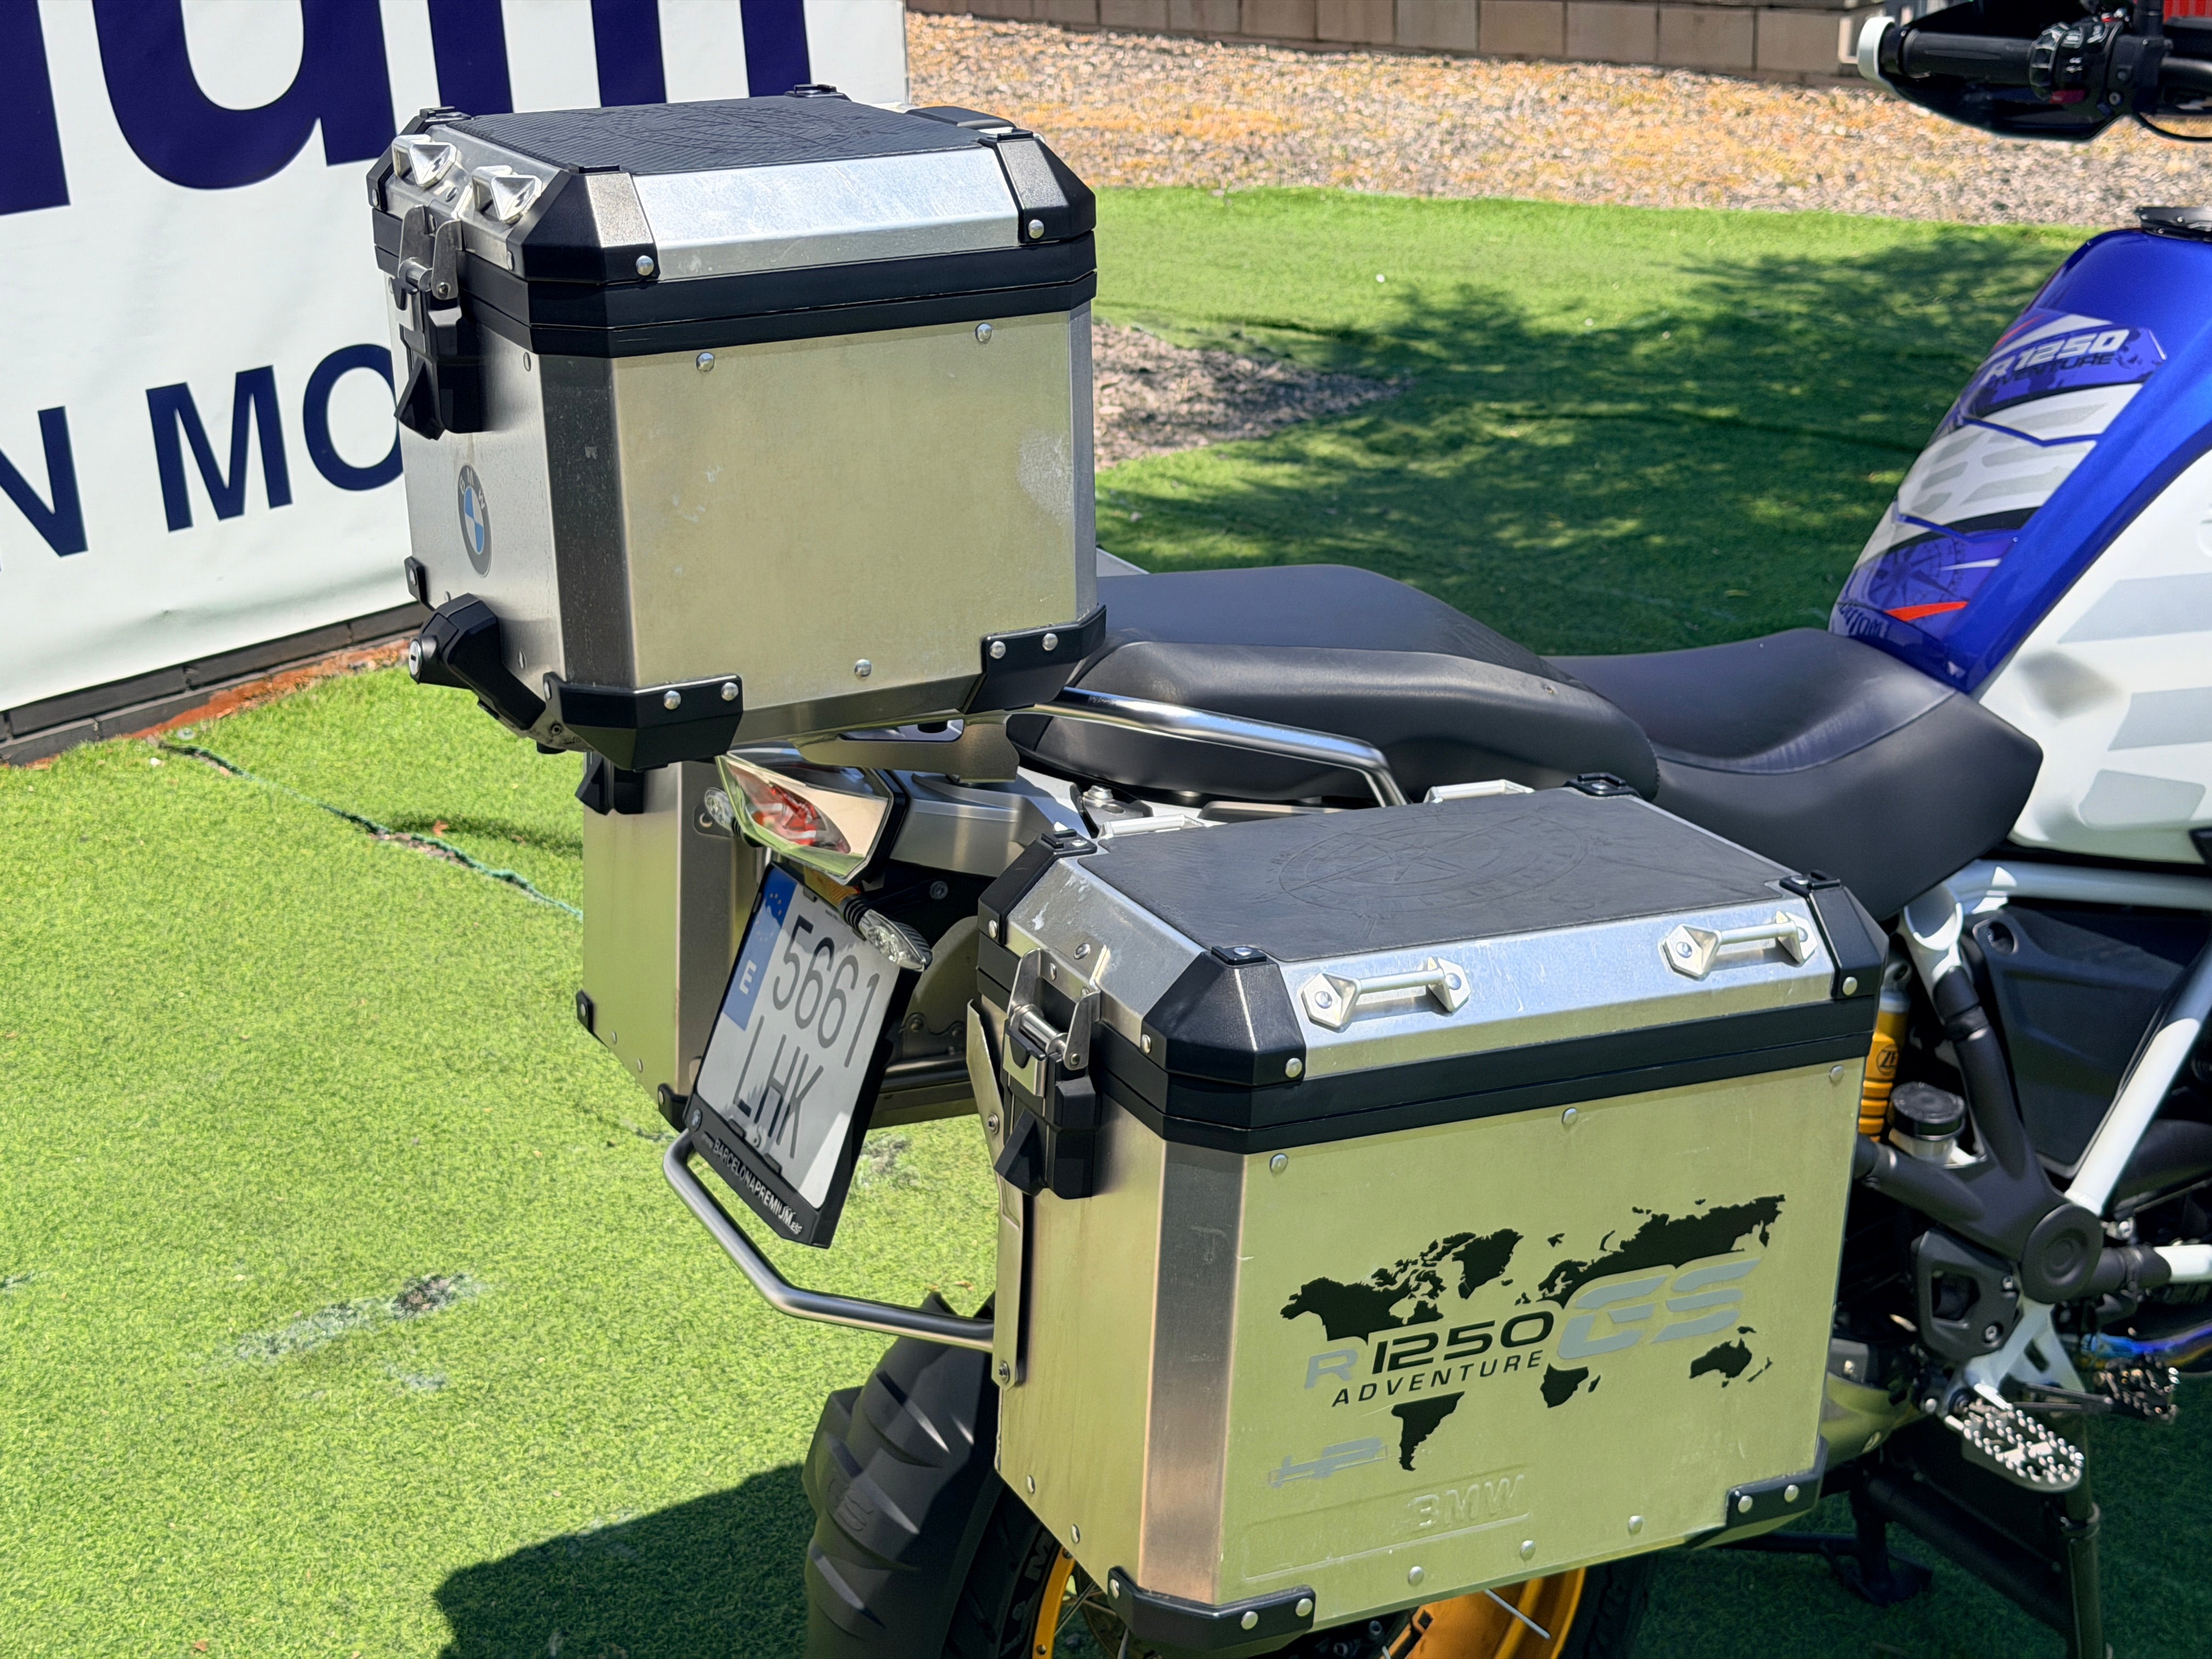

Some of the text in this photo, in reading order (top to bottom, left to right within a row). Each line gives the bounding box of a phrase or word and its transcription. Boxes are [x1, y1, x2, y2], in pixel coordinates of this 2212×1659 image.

[2015, 329, 2130, 372] 1250
[459, 467, 486, 510] BMW
[739, 960, 758, 996] E
[772, 914, 881, 1068] 5661
[733, 1015, 824, 1159] LHK
[1304, 1257, 1762, 1390] R 1250 GS
[1330, 1349, 1545, 1408] ADVENTURE
